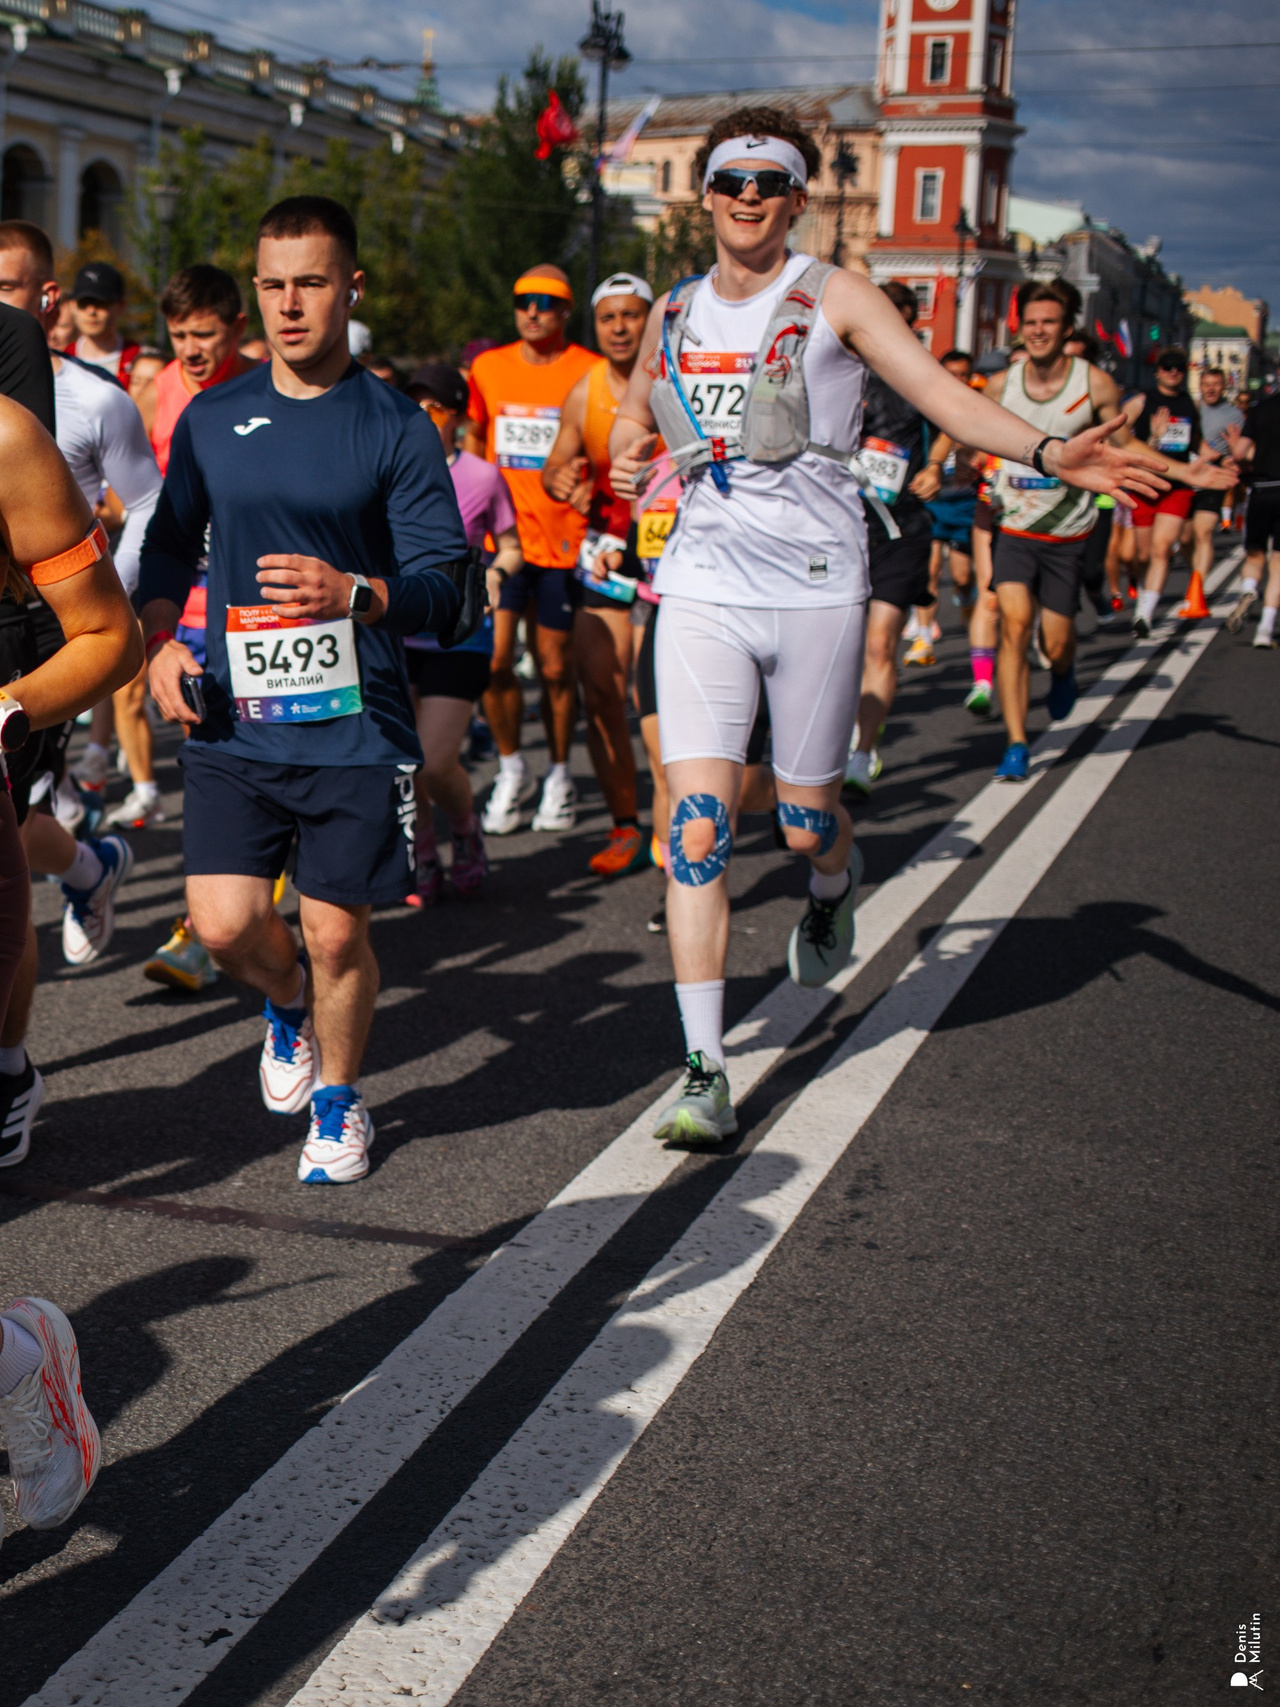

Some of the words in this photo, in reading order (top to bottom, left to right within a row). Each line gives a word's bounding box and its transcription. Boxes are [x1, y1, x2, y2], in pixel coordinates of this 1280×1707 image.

[504, 421, 554, 445] 5289
[240, 615, 279, 624] МАРАФОН
[244, 634, 340, 676] 5493
[266, 673, 324, 689] ВИТАЛИЙ
[247, 700, 263, 719] E
